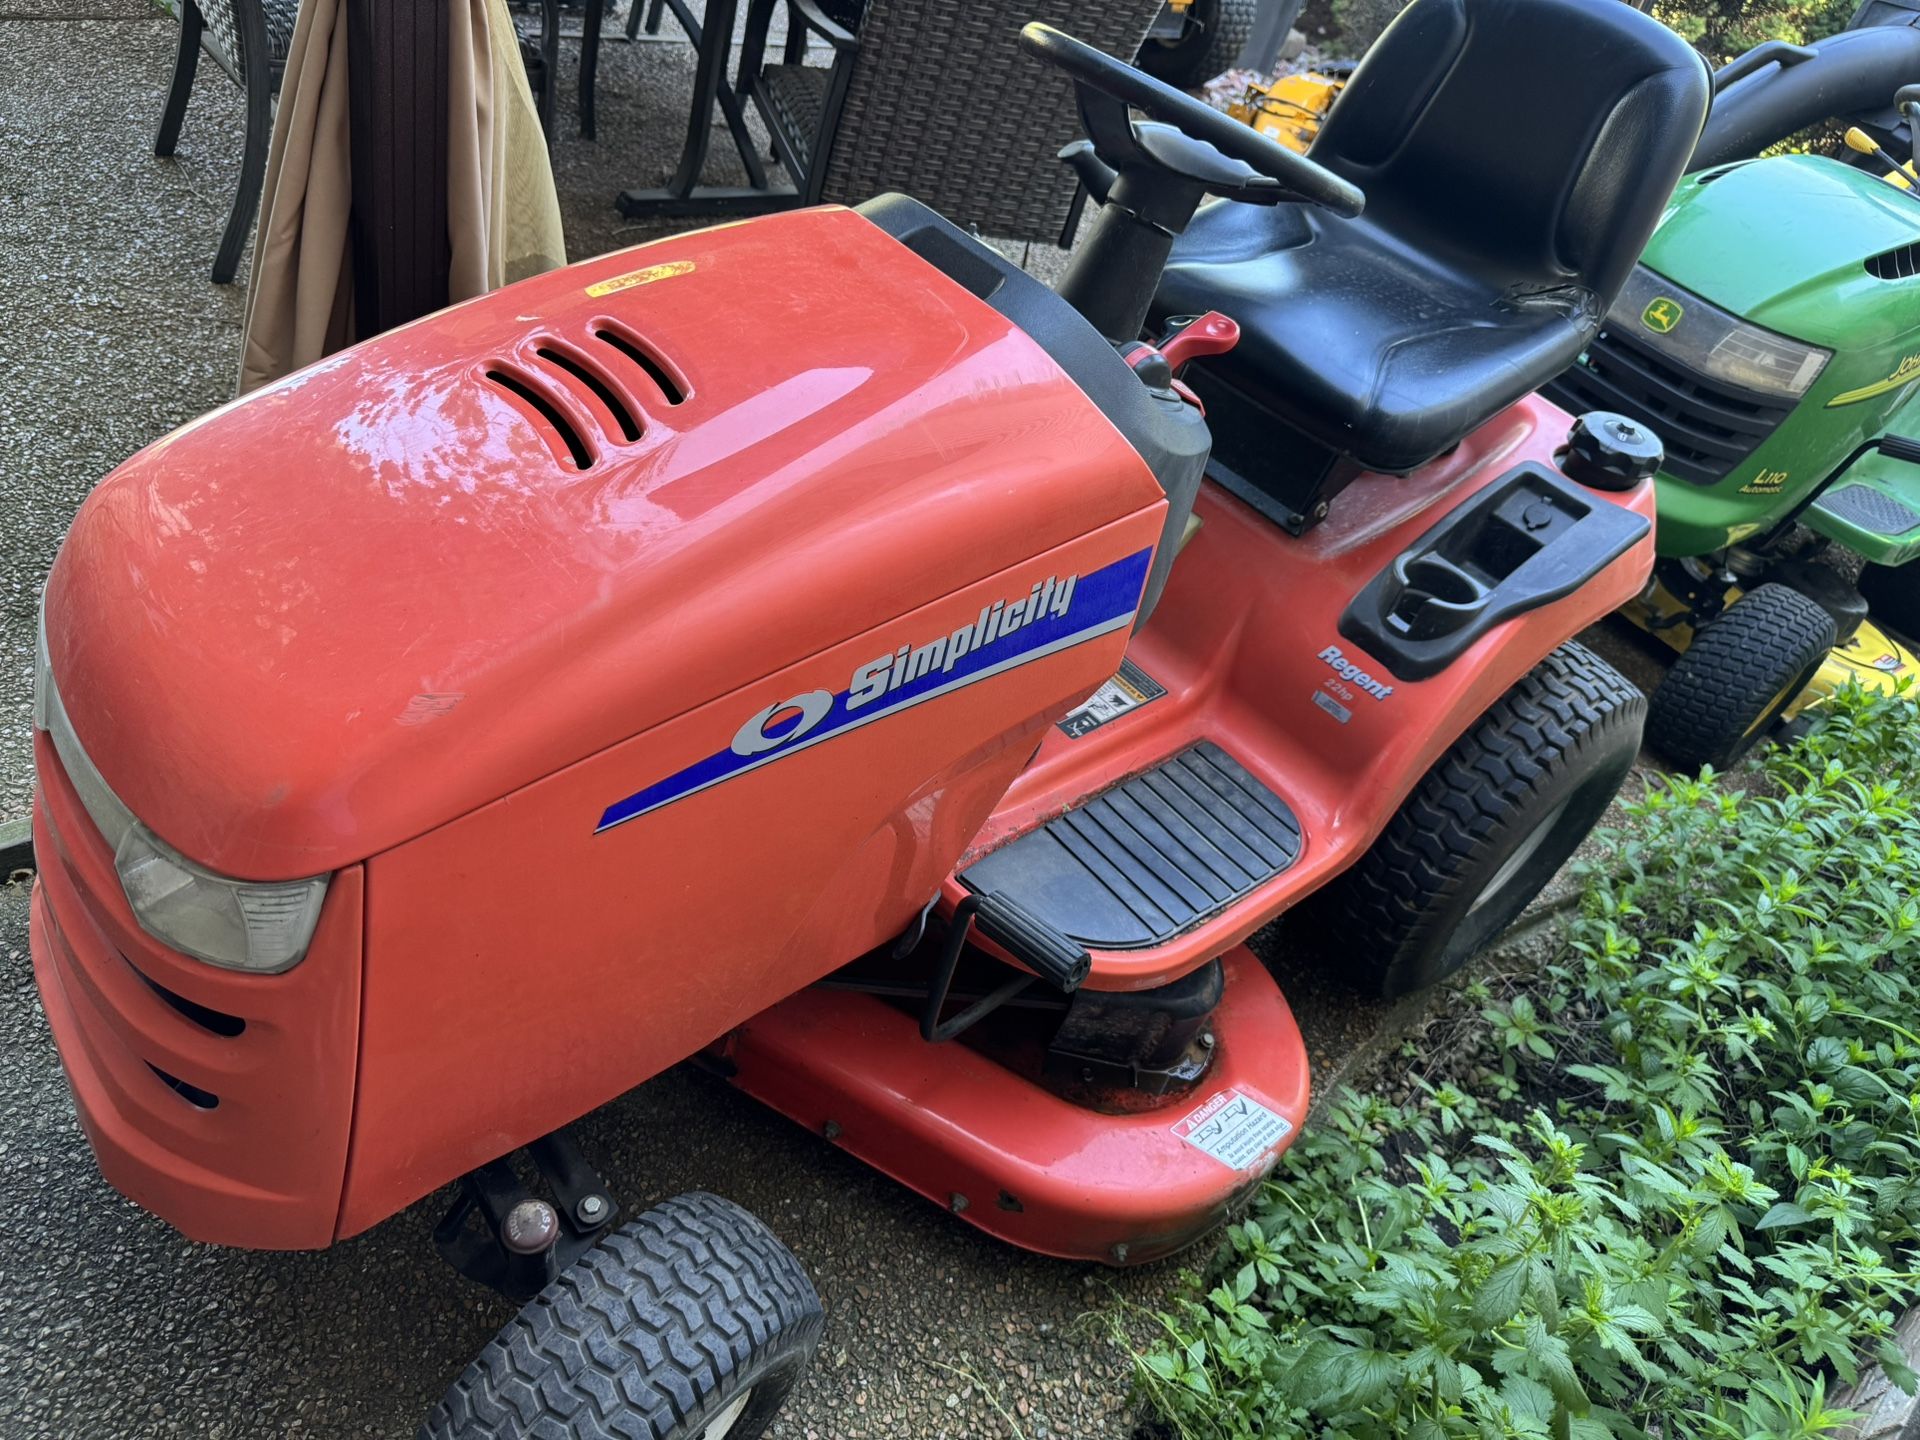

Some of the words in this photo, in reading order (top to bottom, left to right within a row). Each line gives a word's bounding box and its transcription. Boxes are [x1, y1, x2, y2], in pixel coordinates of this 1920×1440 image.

[1888, 353, 1920, 379] JOH
[1738, 484, 1783, 494] Automatic
[1753, 468, 1788, 484] L110
[846, 573, 1079, 711] Simplicity
[1317, 645, 1395, 701] Regent
[1196, 1094, 1228, 1124] DANGER
[1216, 1127, 1249, 1155] Amputation
[1246, 1111, 1267, 1130] Hazard
[536, 1203, 551, 1233] CAST
